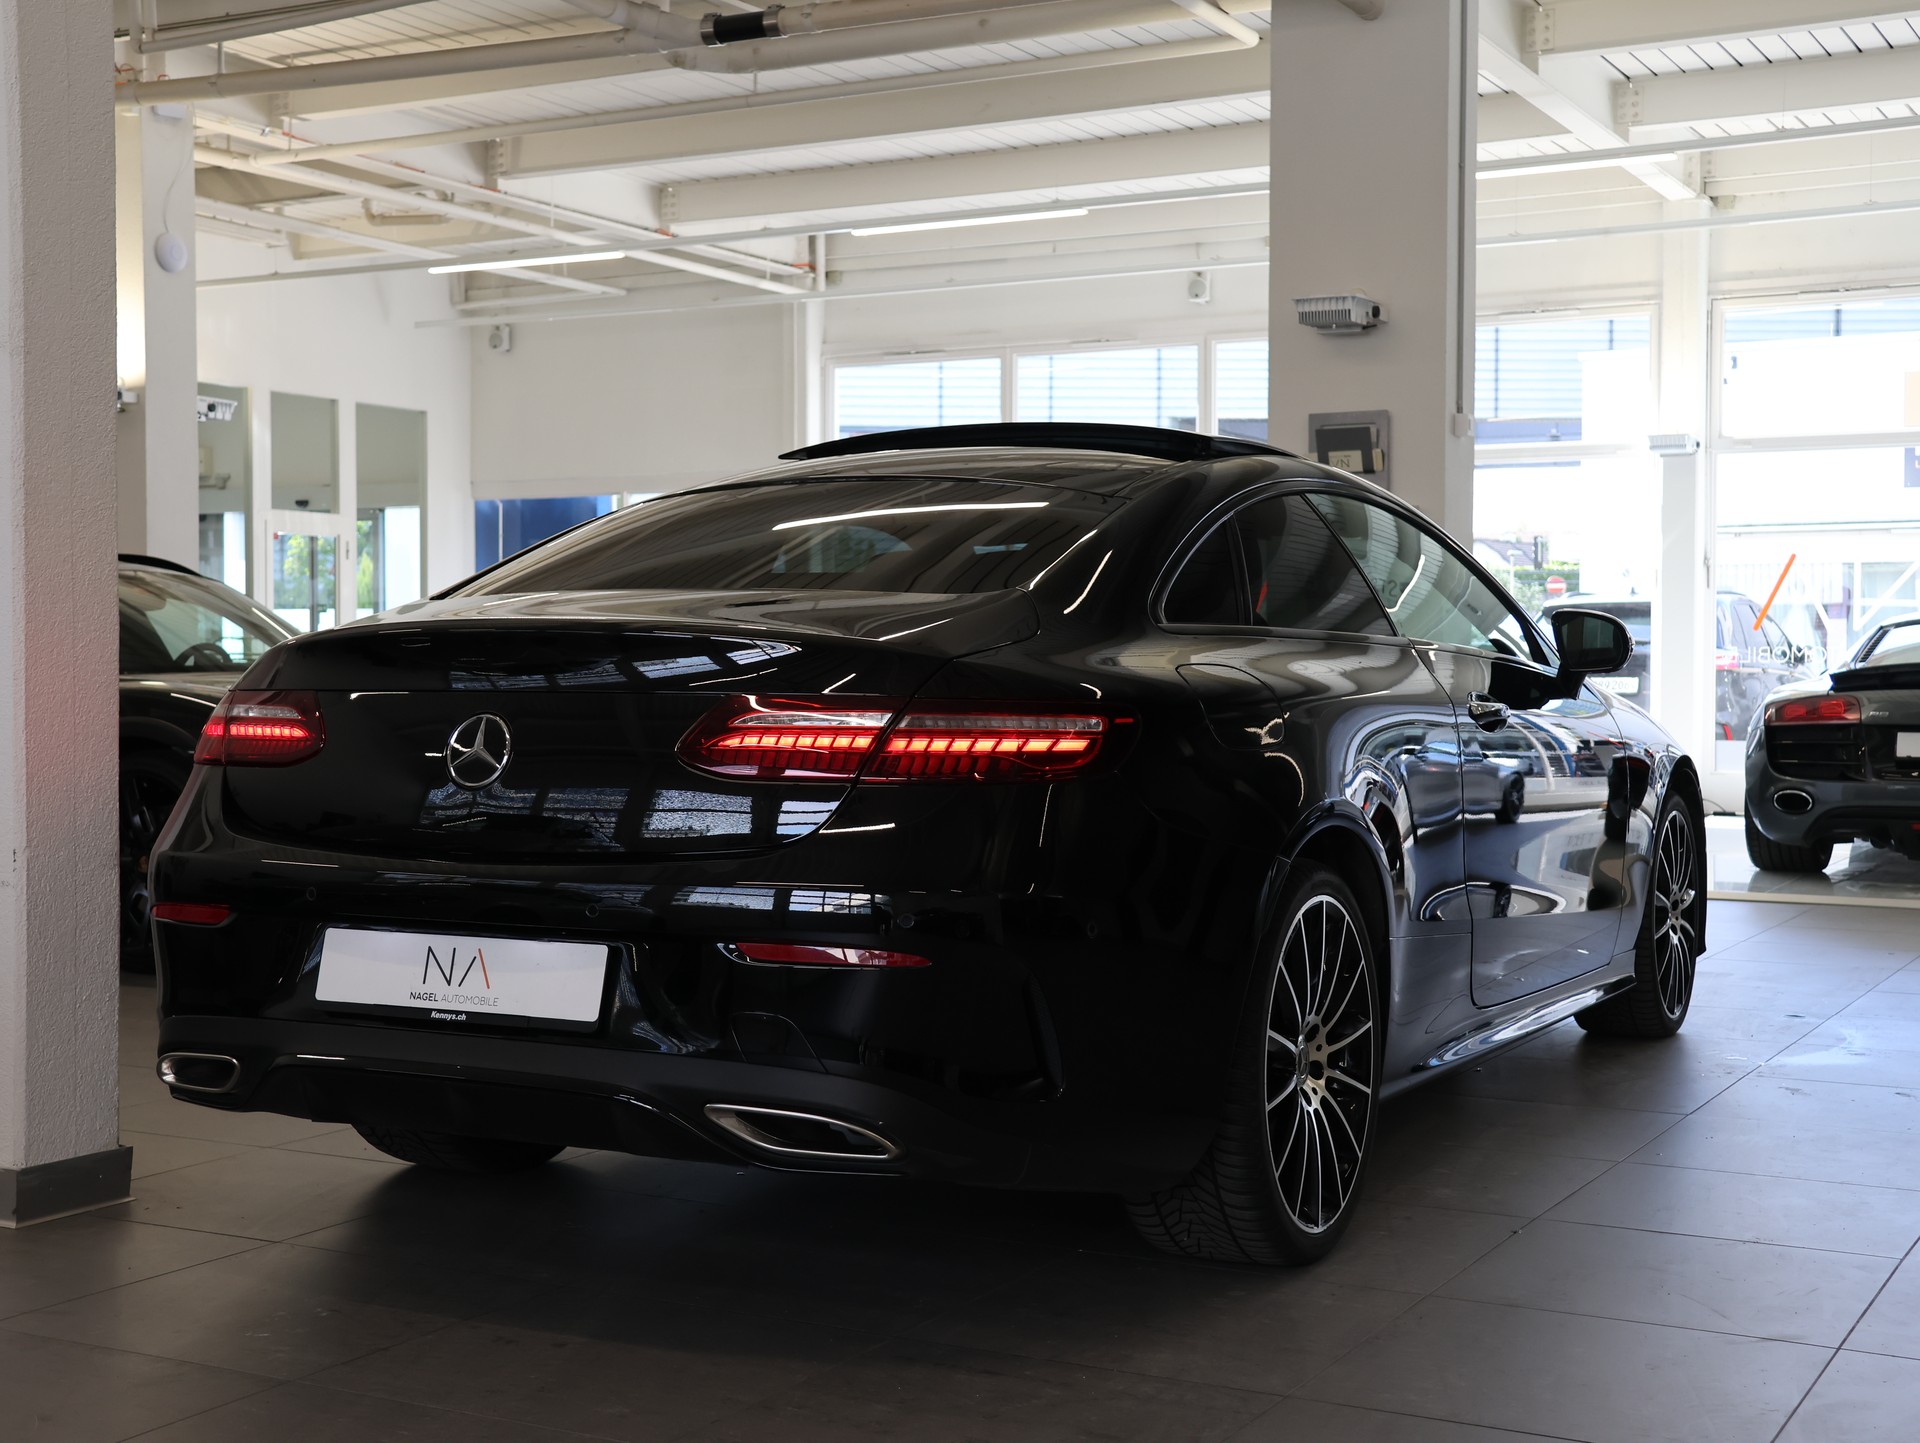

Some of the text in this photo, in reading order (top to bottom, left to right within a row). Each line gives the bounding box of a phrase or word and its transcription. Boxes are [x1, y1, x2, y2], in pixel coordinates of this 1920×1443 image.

[409, 992, 499, 1006] NAGEL AUTOMOBILE
[431, 1010, 466, 1020] Kennys.ch
